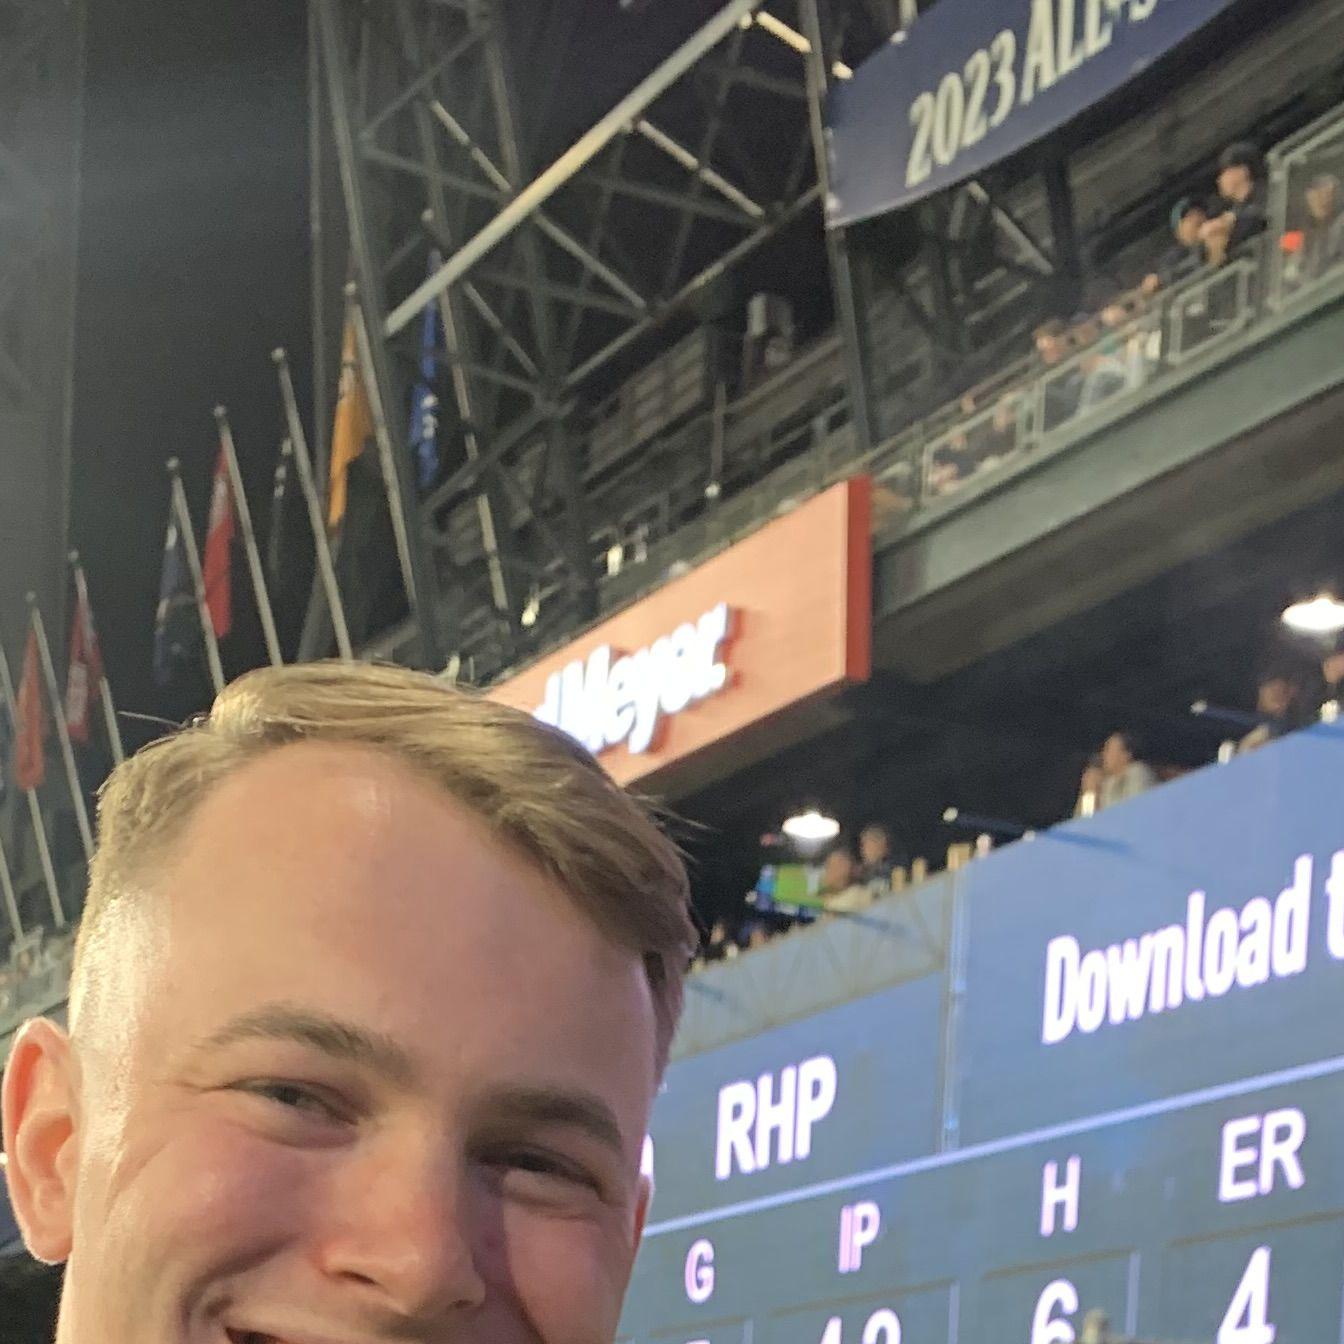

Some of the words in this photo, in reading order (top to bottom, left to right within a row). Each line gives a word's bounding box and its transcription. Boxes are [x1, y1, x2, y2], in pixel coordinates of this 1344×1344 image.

[905, 29, 1016, 188] 2023
[1042, 854, 1314, 1044] Download
[685, 1239, 715, 1303] G
[838, 1201, 881, 1272] IP
[1040, 1157, 1080, 1236] H
[1218, 1107, 1306, 1202] ER
[715, 1056, 837, 1181] RHP
